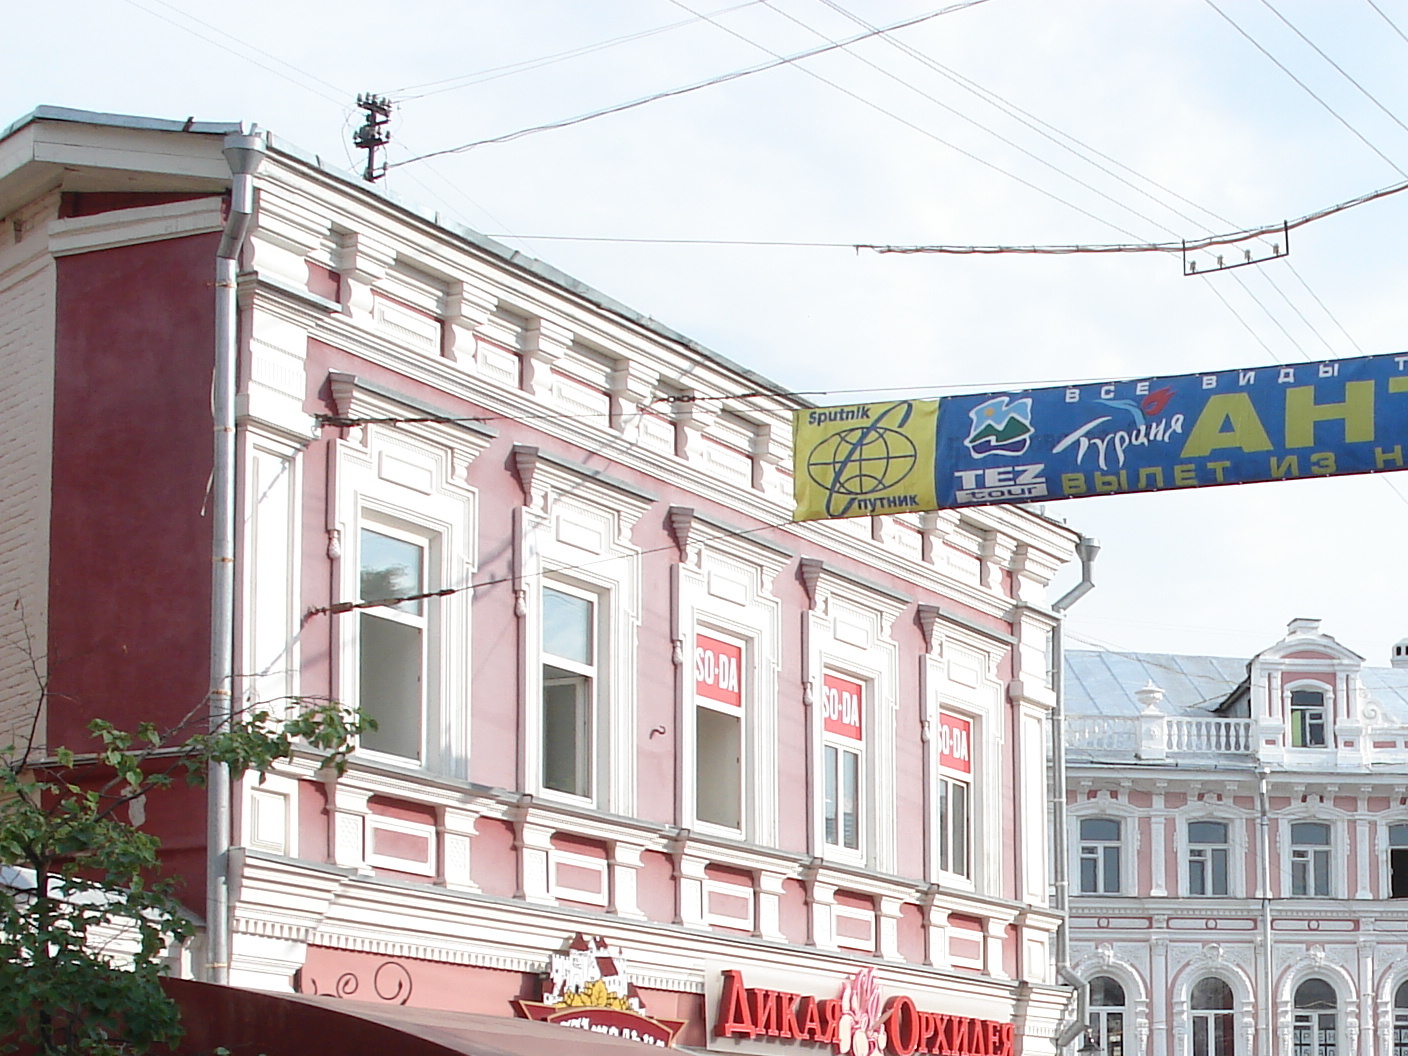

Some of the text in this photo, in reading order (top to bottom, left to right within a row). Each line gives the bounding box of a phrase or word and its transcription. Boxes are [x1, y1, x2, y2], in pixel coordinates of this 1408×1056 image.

[1065, 382, 1149, 403] ВСЕ
[1201, 363, 1339, 390] ВИДЫ
[808, 405, 871, 426] Sputnik
[954, 463, 1047, 490] TEZ
[1061, 461, 1231, 495] ВЫЛЕТ
[1269, 452, 1337, 478] ИЗ
[965, 485, 1037, 499] tour
